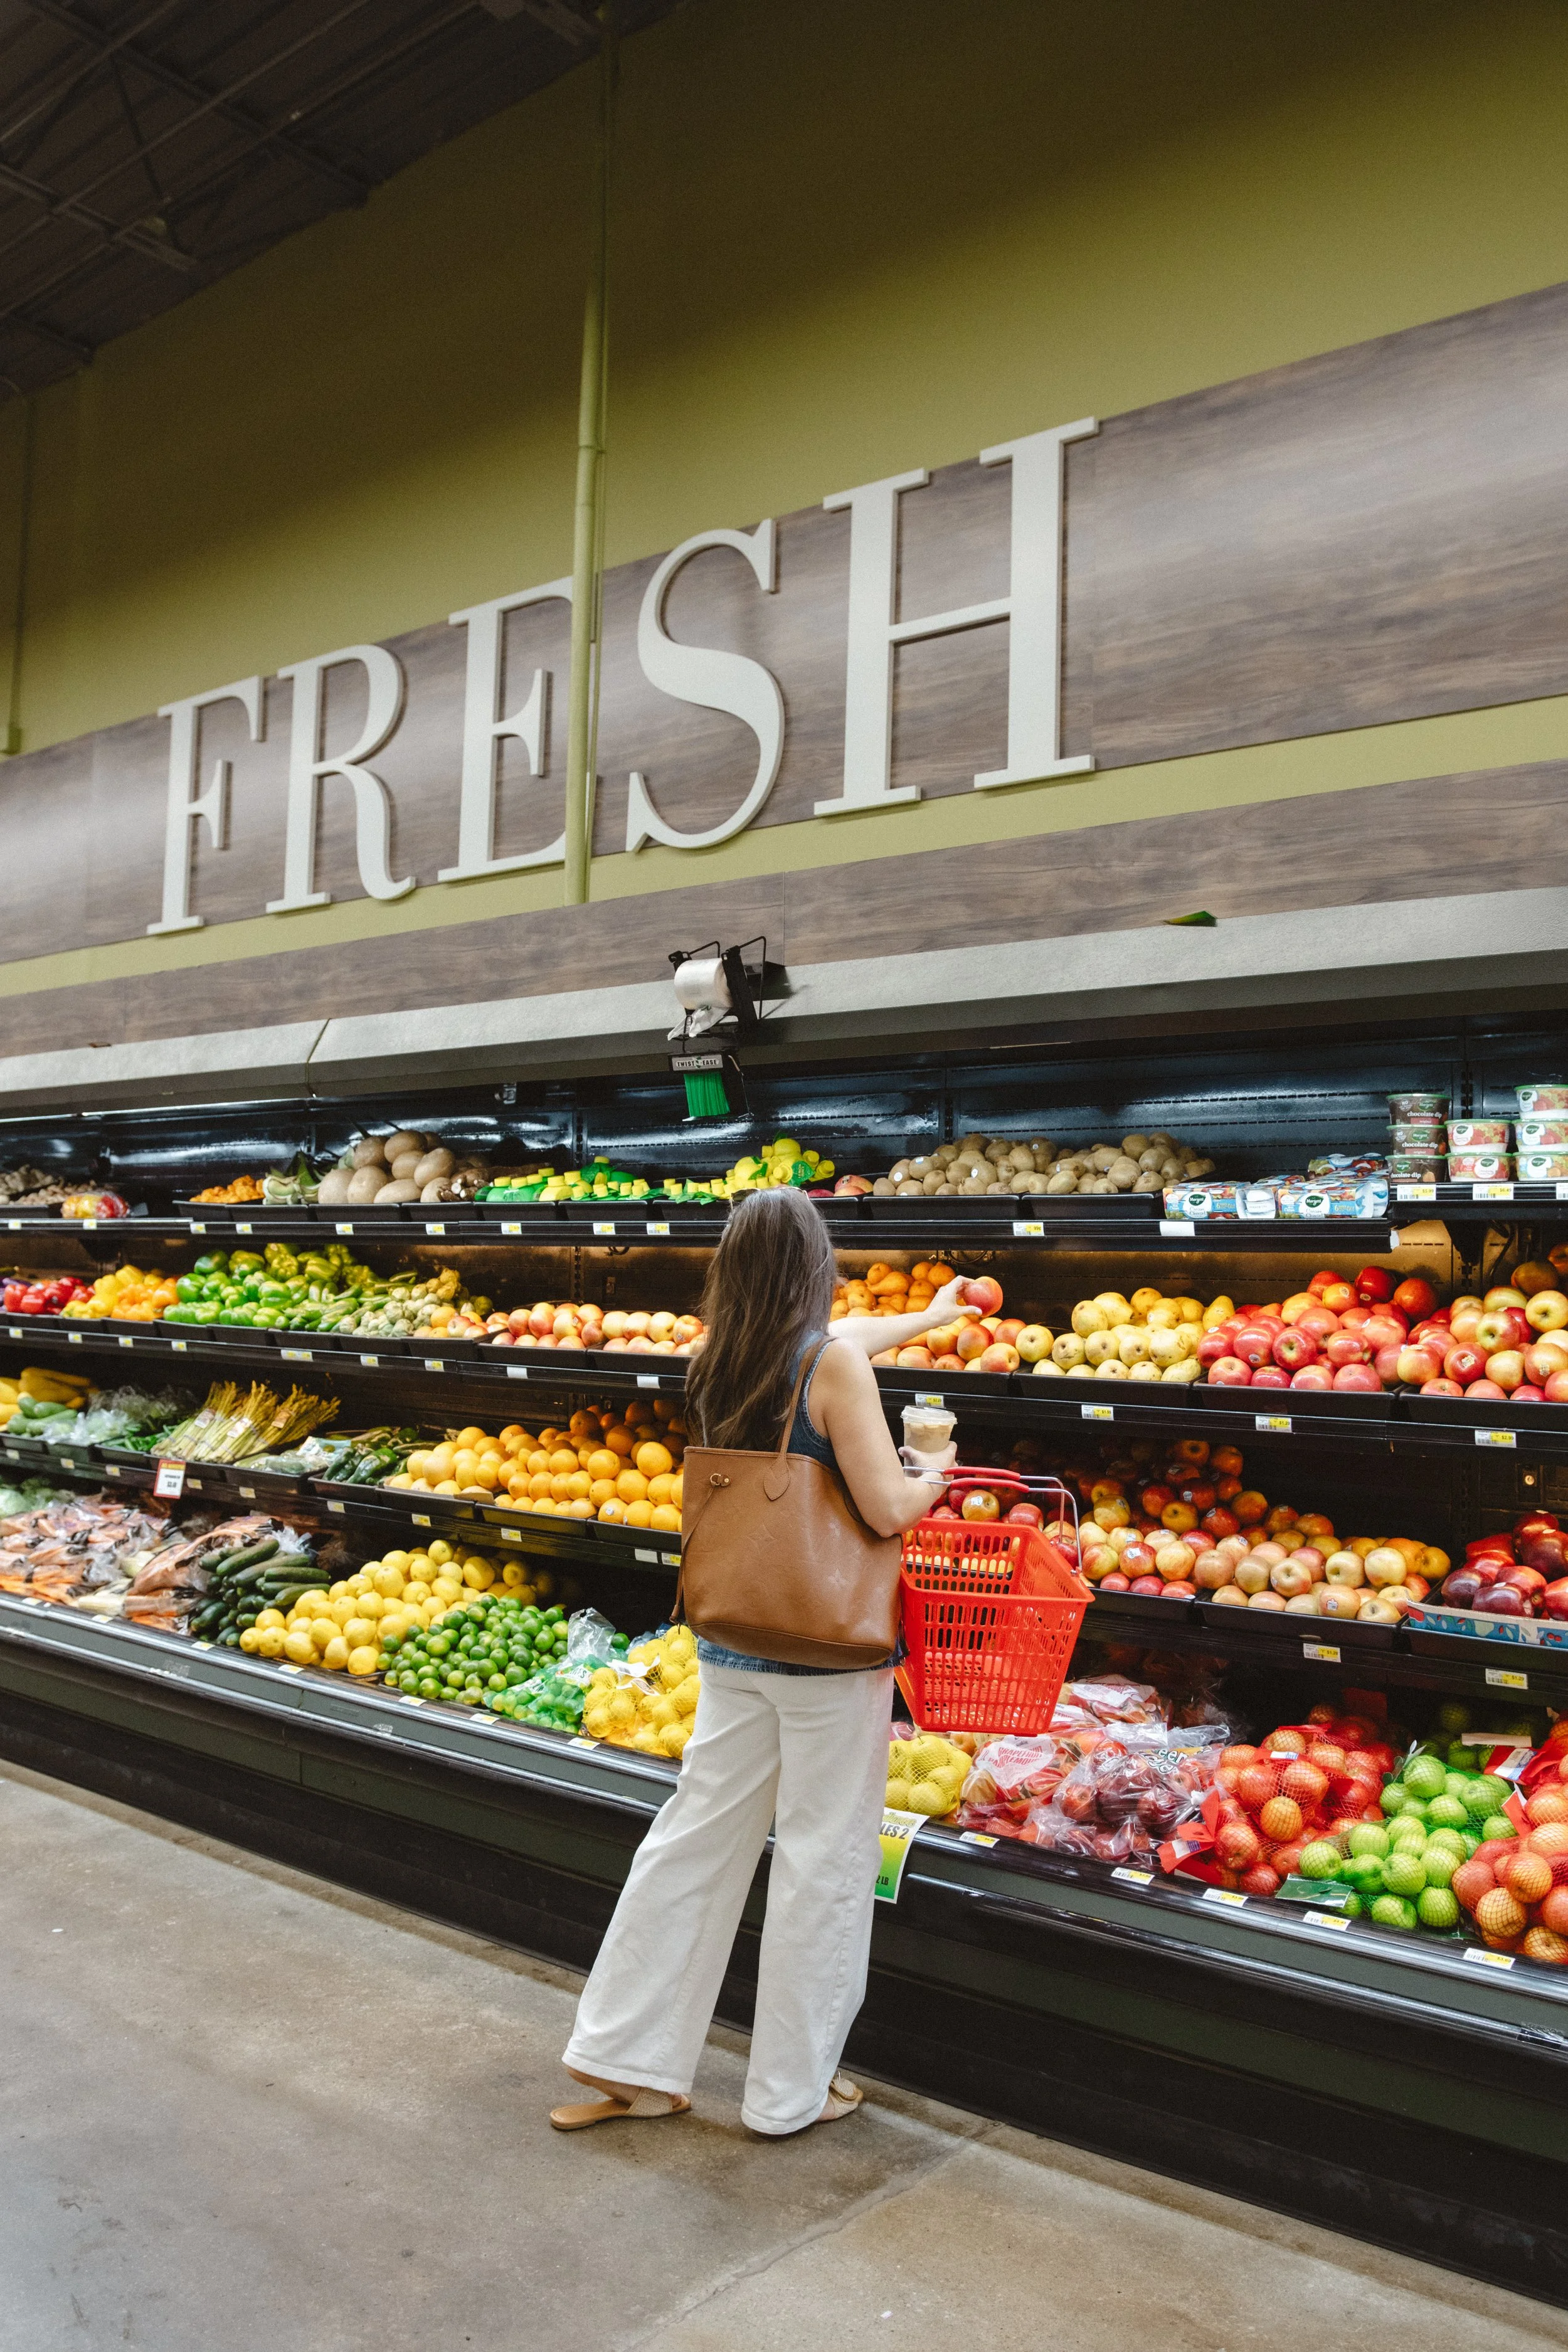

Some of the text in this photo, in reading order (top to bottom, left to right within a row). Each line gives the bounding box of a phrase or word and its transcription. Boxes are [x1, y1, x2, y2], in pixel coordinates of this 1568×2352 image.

[147, 417, 1099, 936] FRESH
[898, 1828, 909, 1840] 2
[881, 1876, 889, 1886] LB
